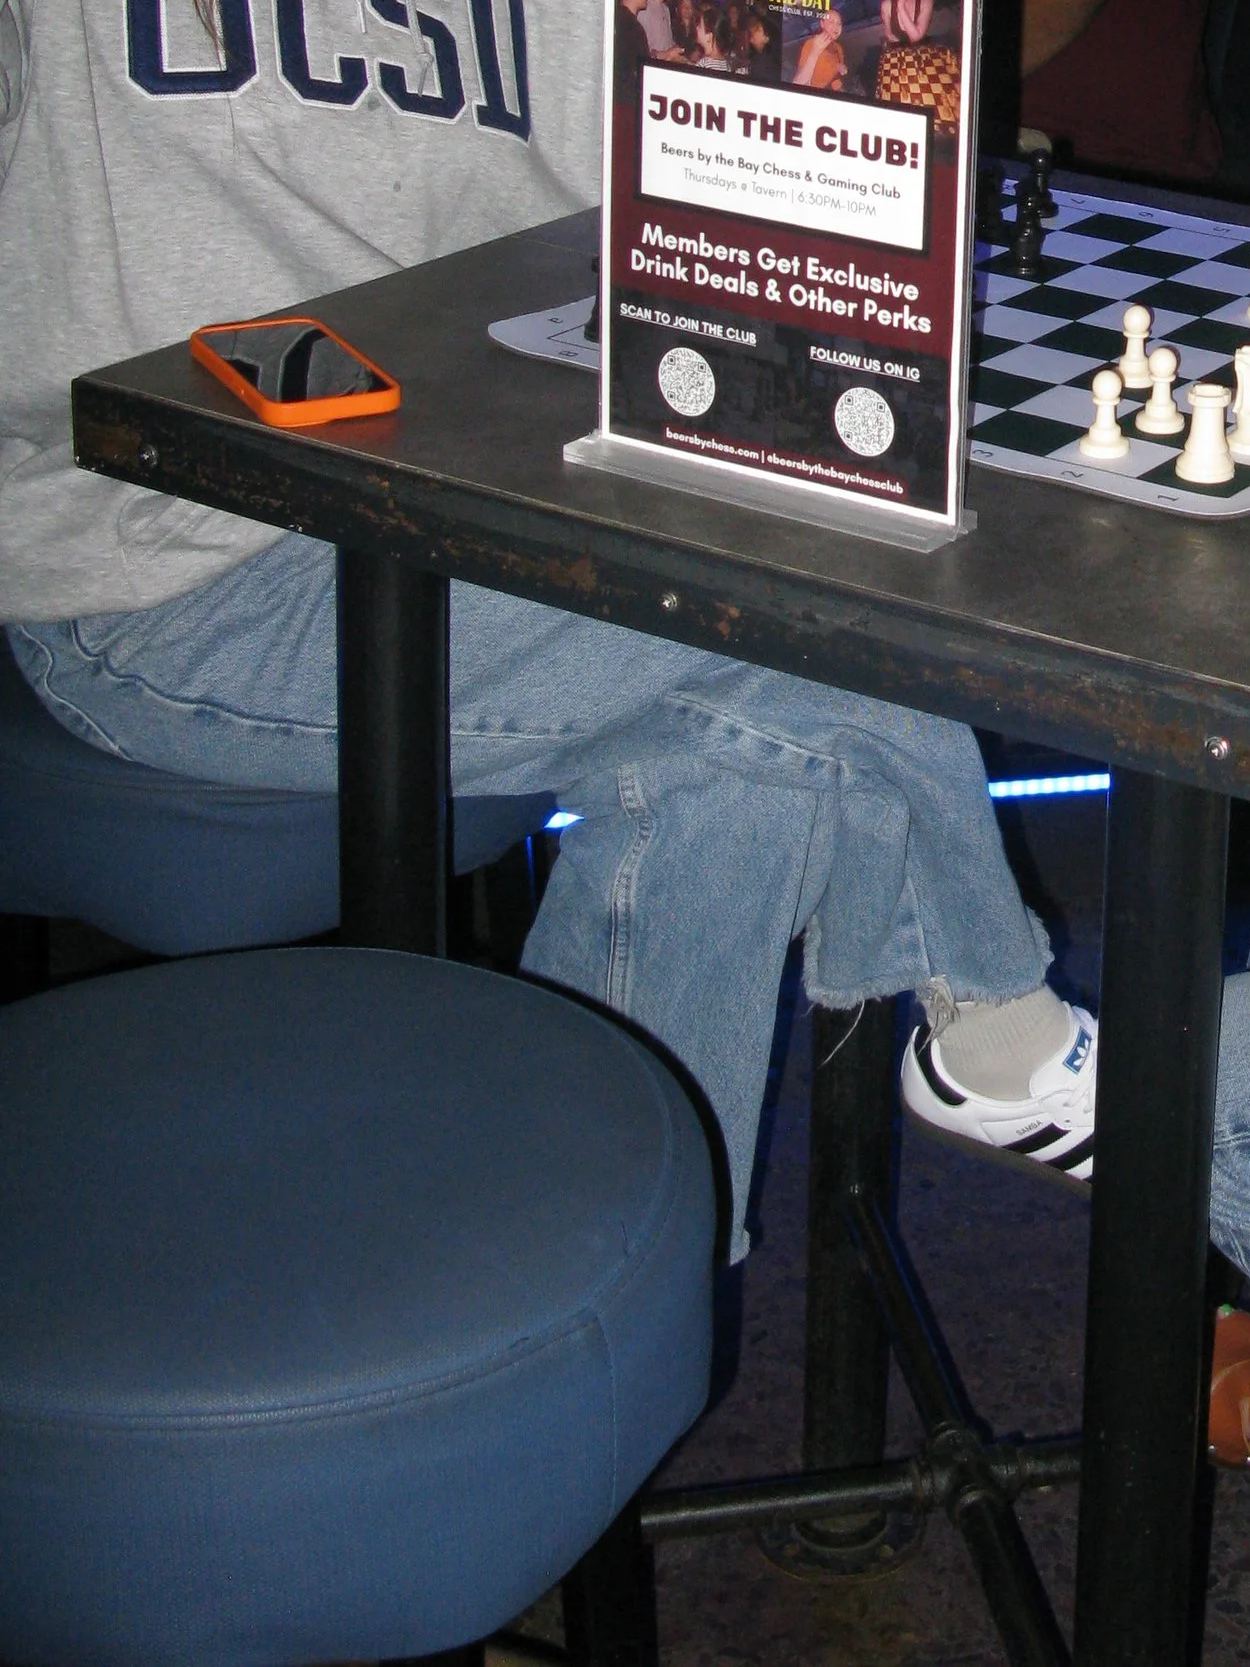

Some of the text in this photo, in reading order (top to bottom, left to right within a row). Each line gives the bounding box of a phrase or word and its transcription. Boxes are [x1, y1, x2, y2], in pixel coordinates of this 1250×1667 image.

[648, 94, 919, 169] JOIN THE CLUB!
[661, 142, 901, 200] Beers by the Bay Chess & Gaming Club
[683, 167, 738, 191] Thursdays
[752, 182, 787, 199] Tavern
[641, 222, 919, 301] Members Get Exclusive
[631, 248, 932, 334] Drink Deals & Other Perks
[620, 302, 757, 345] SCAN TO JOIN THE CLUB
[809, 345, 921, 380] FOLLOW US ON IG
[666, 426, 759, 461] beersbychess.com
